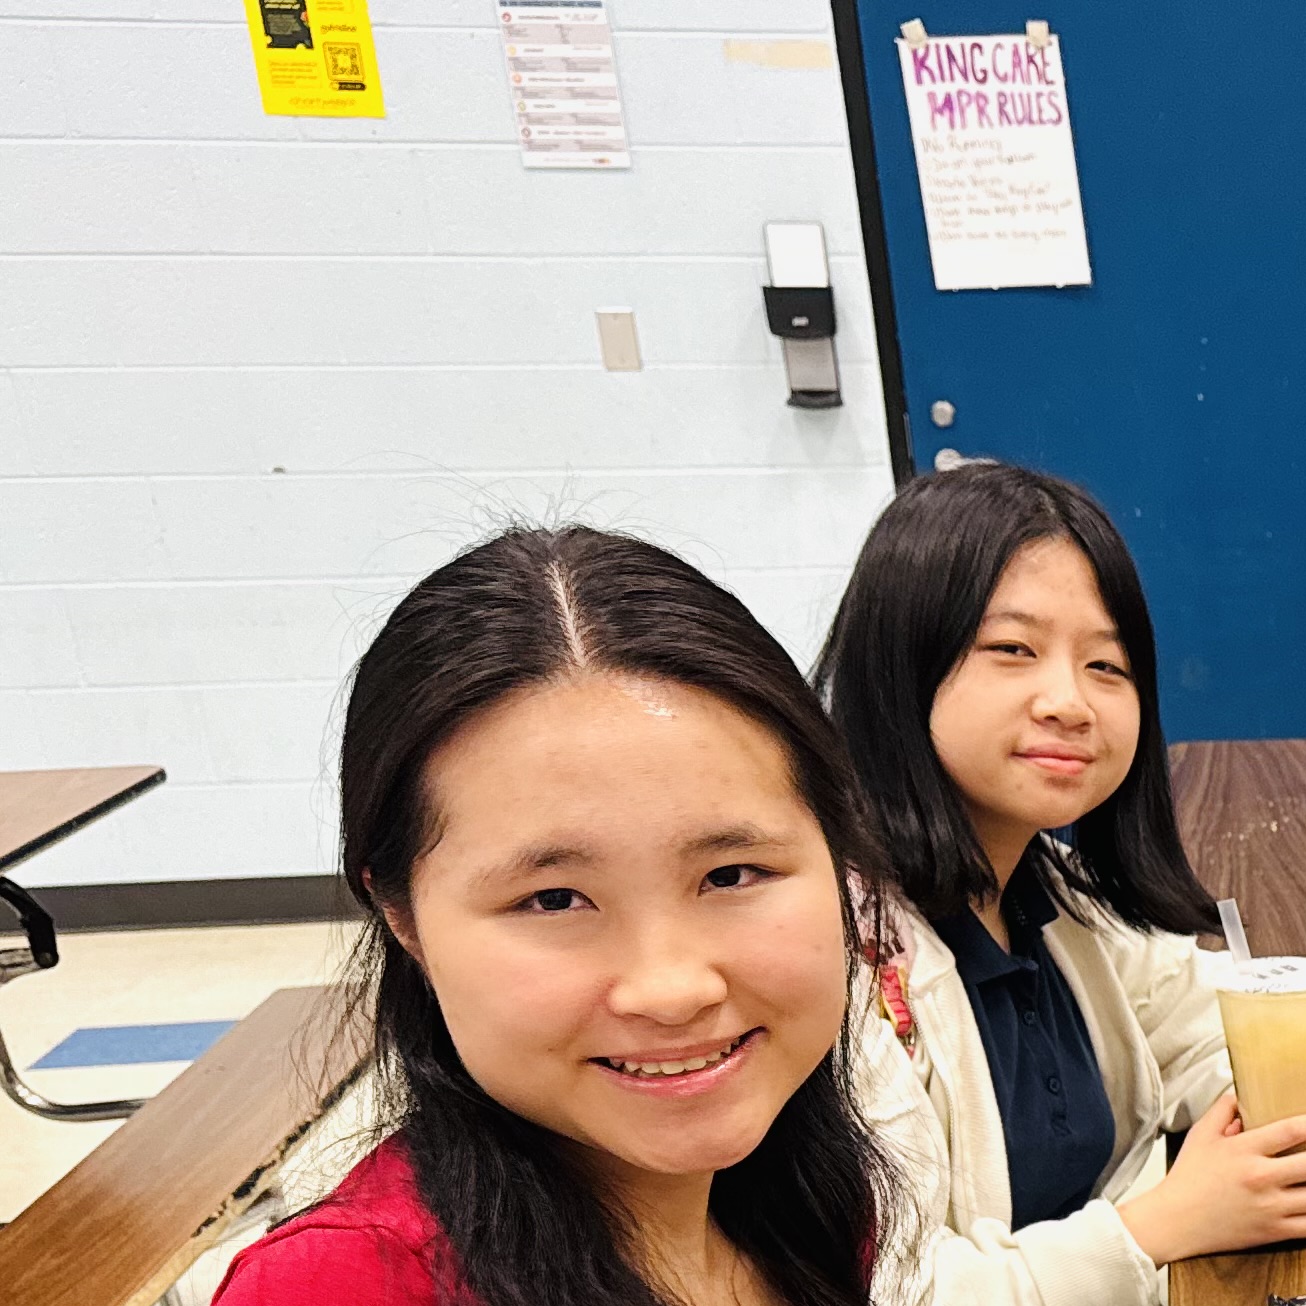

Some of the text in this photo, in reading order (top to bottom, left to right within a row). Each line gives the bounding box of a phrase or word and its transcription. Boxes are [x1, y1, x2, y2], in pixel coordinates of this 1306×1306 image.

[912, 42, 988, 86] KING
[927, 89, 1063, 131] MPR RULES
